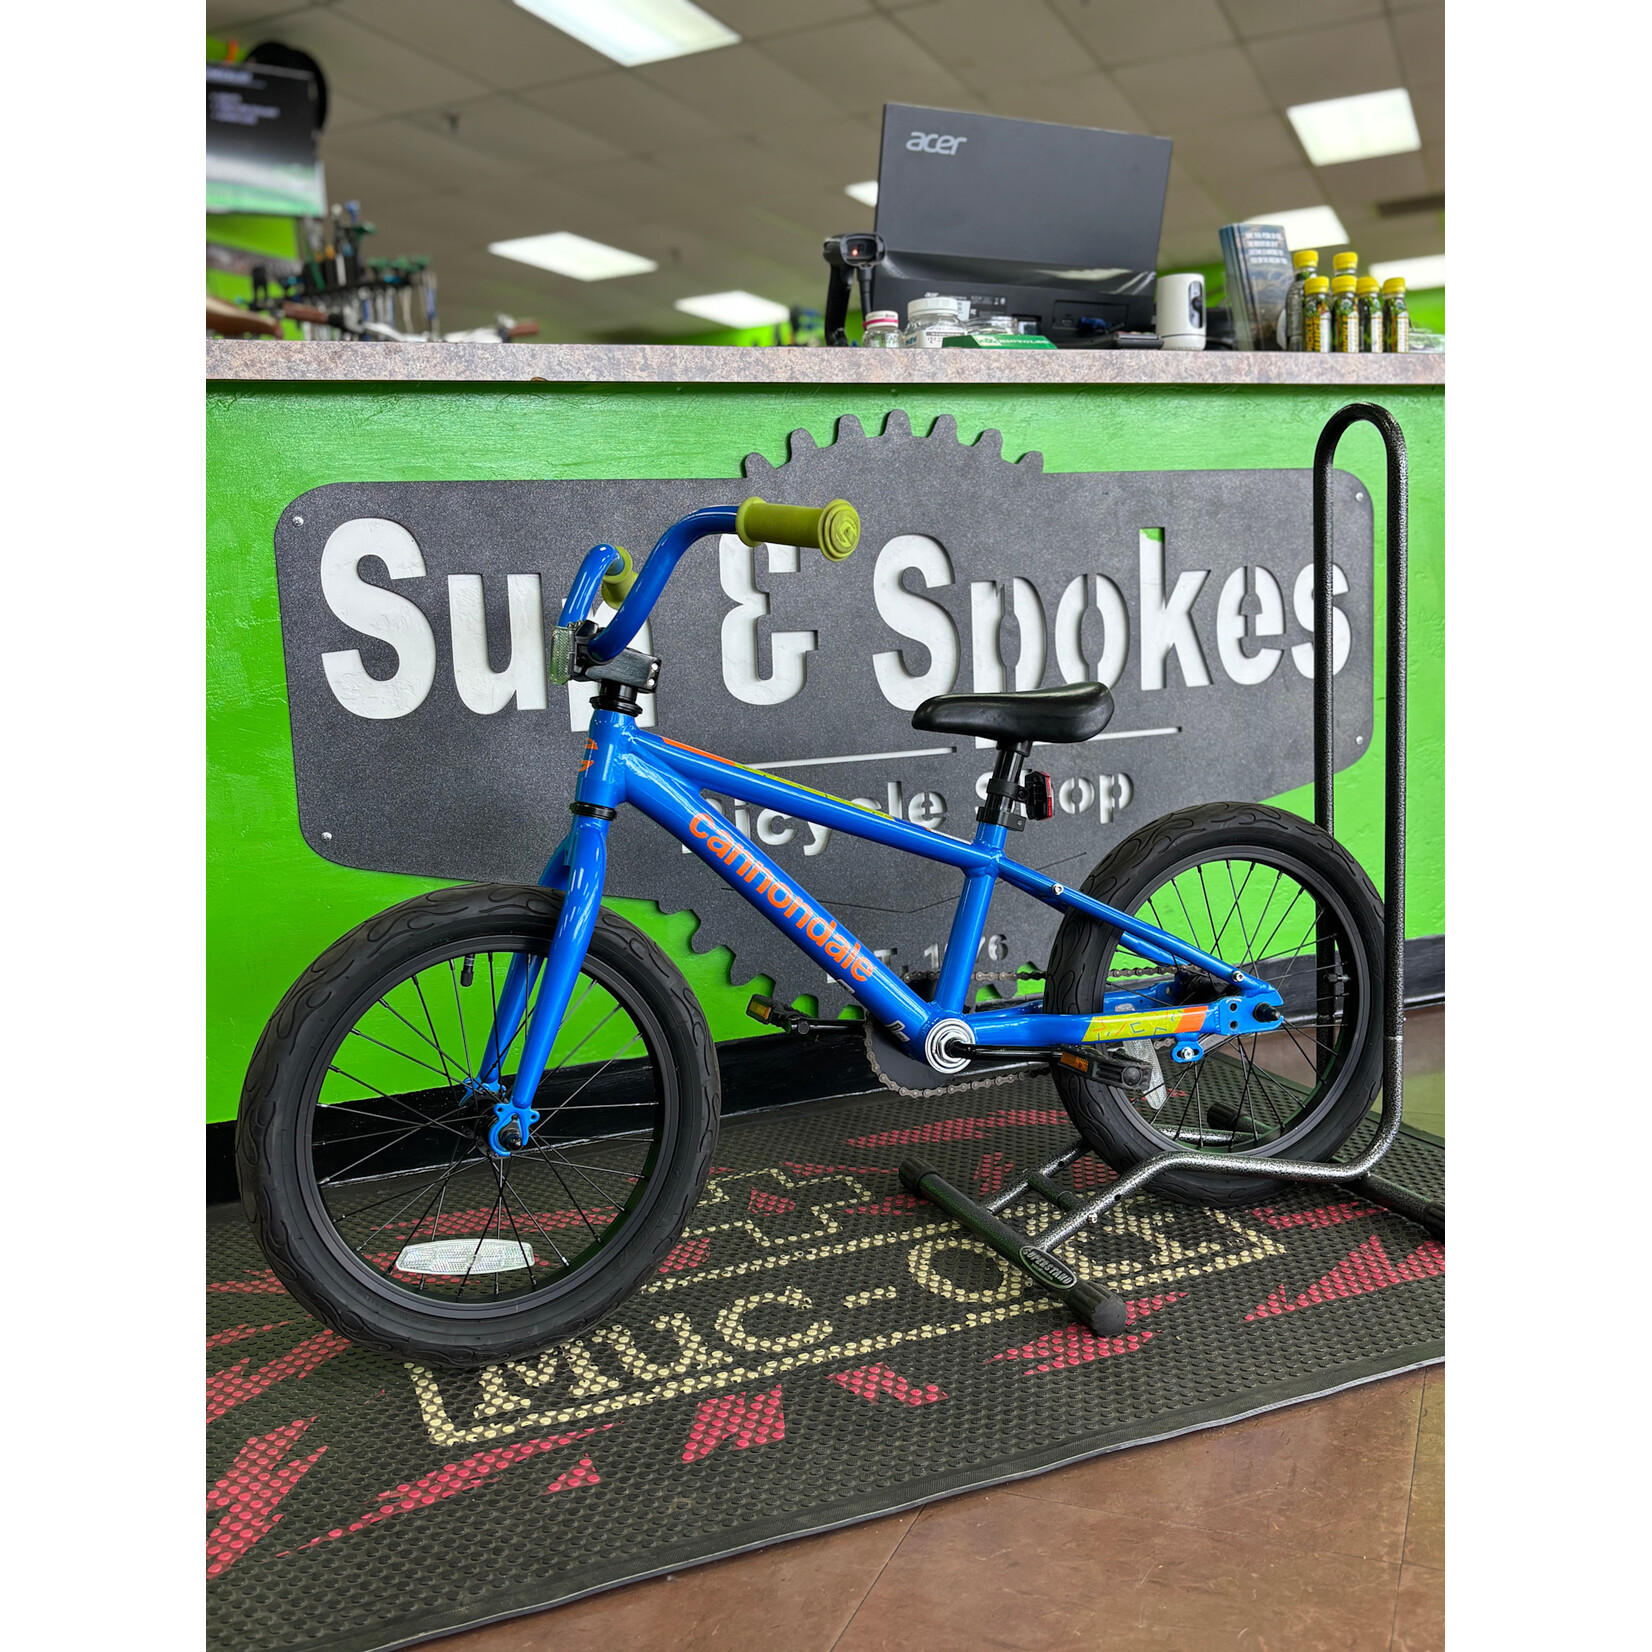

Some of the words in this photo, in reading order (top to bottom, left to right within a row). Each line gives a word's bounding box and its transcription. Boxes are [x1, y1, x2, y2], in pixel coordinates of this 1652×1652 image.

[905, 131, 968, 156] acer
[718, 530, 819, 706] &
[872, 526, 1353, 748] Spokes
[688, 812, 874, 983] cannondale
[1022, 1246, 1074, 1285] SUPERSTAND
